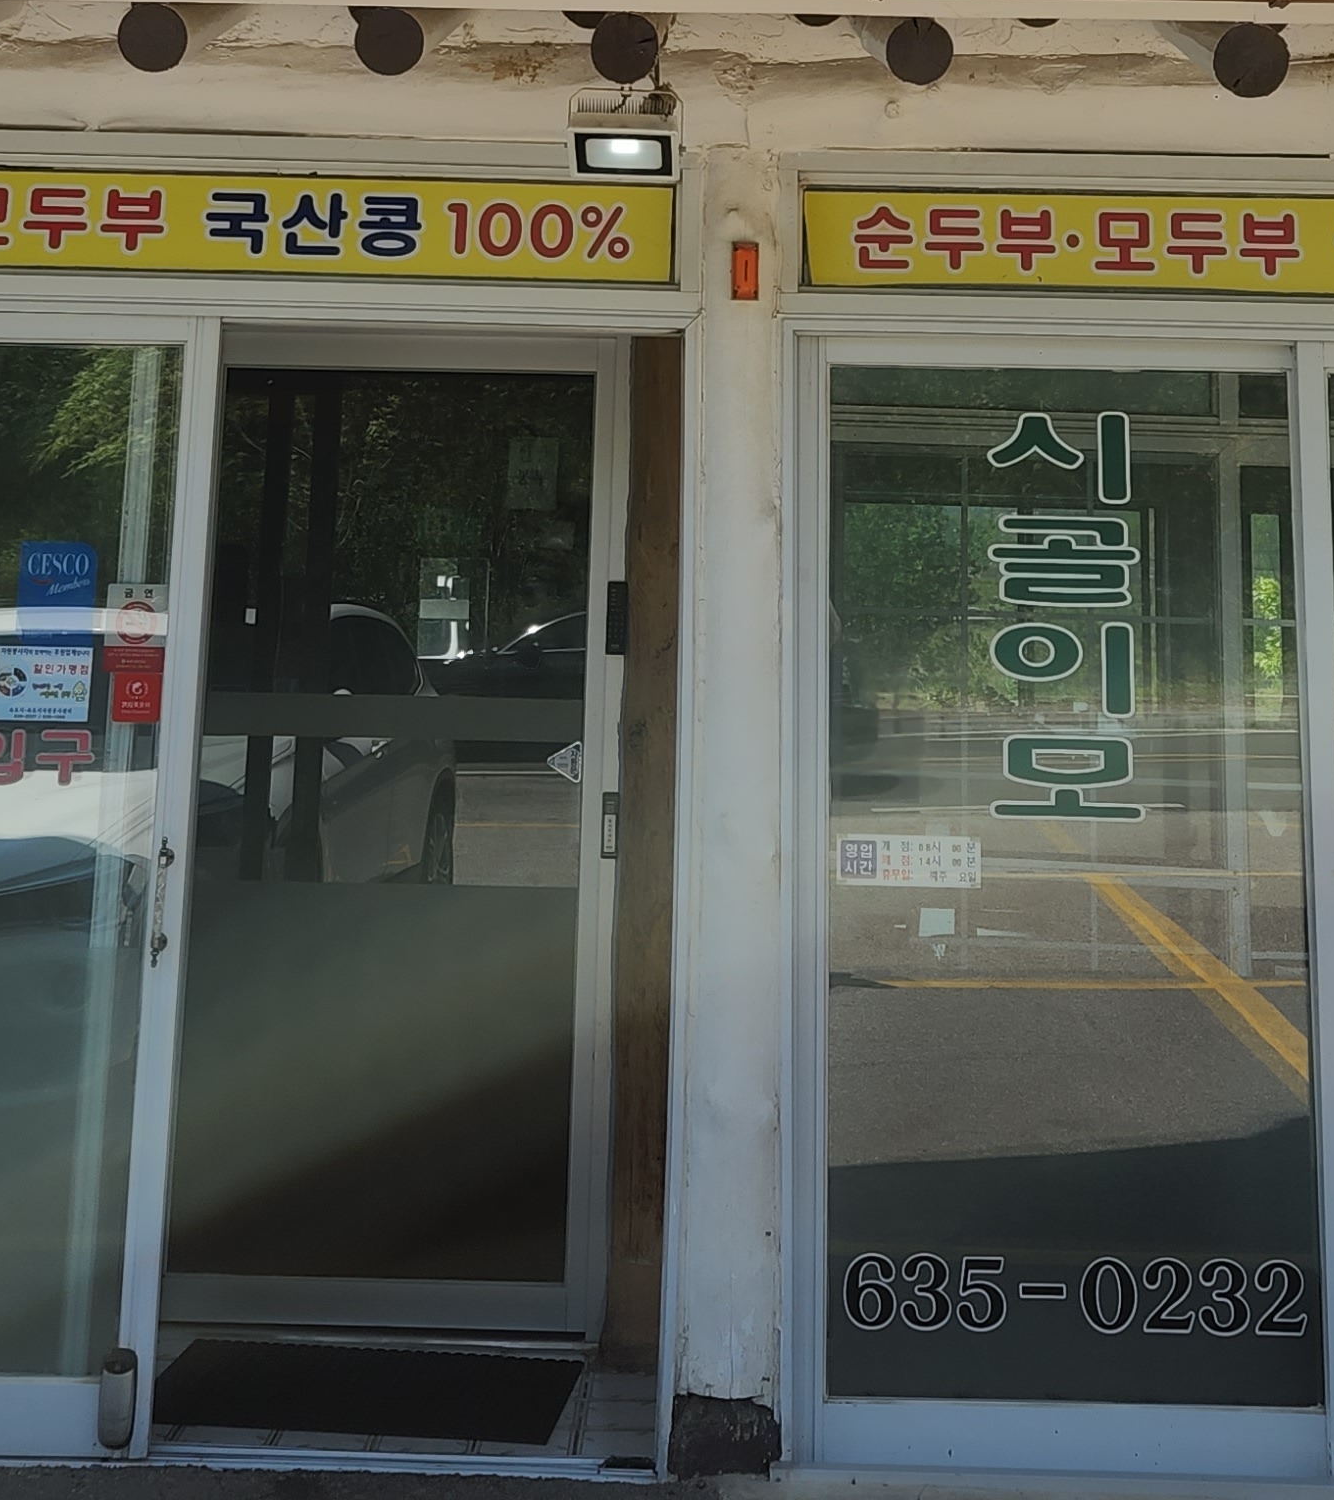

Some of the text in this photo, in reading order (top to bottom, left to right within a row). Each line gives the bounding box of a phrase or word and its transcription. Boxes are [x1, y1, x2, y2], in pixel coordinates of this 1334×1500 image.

[204, 190, 423, 258] 국산콩
[446, 200, 631, 261] 100%
[27, 552, 90, 577] CESCO
[45, 577, 91, 597] Members
[987, 410, 1147, 823] 시골이모
[845, 843, 873, 858] 영업
[844, 859, 873, 875] 시간
[842, 1252, 1309, 1337] 635-0232
